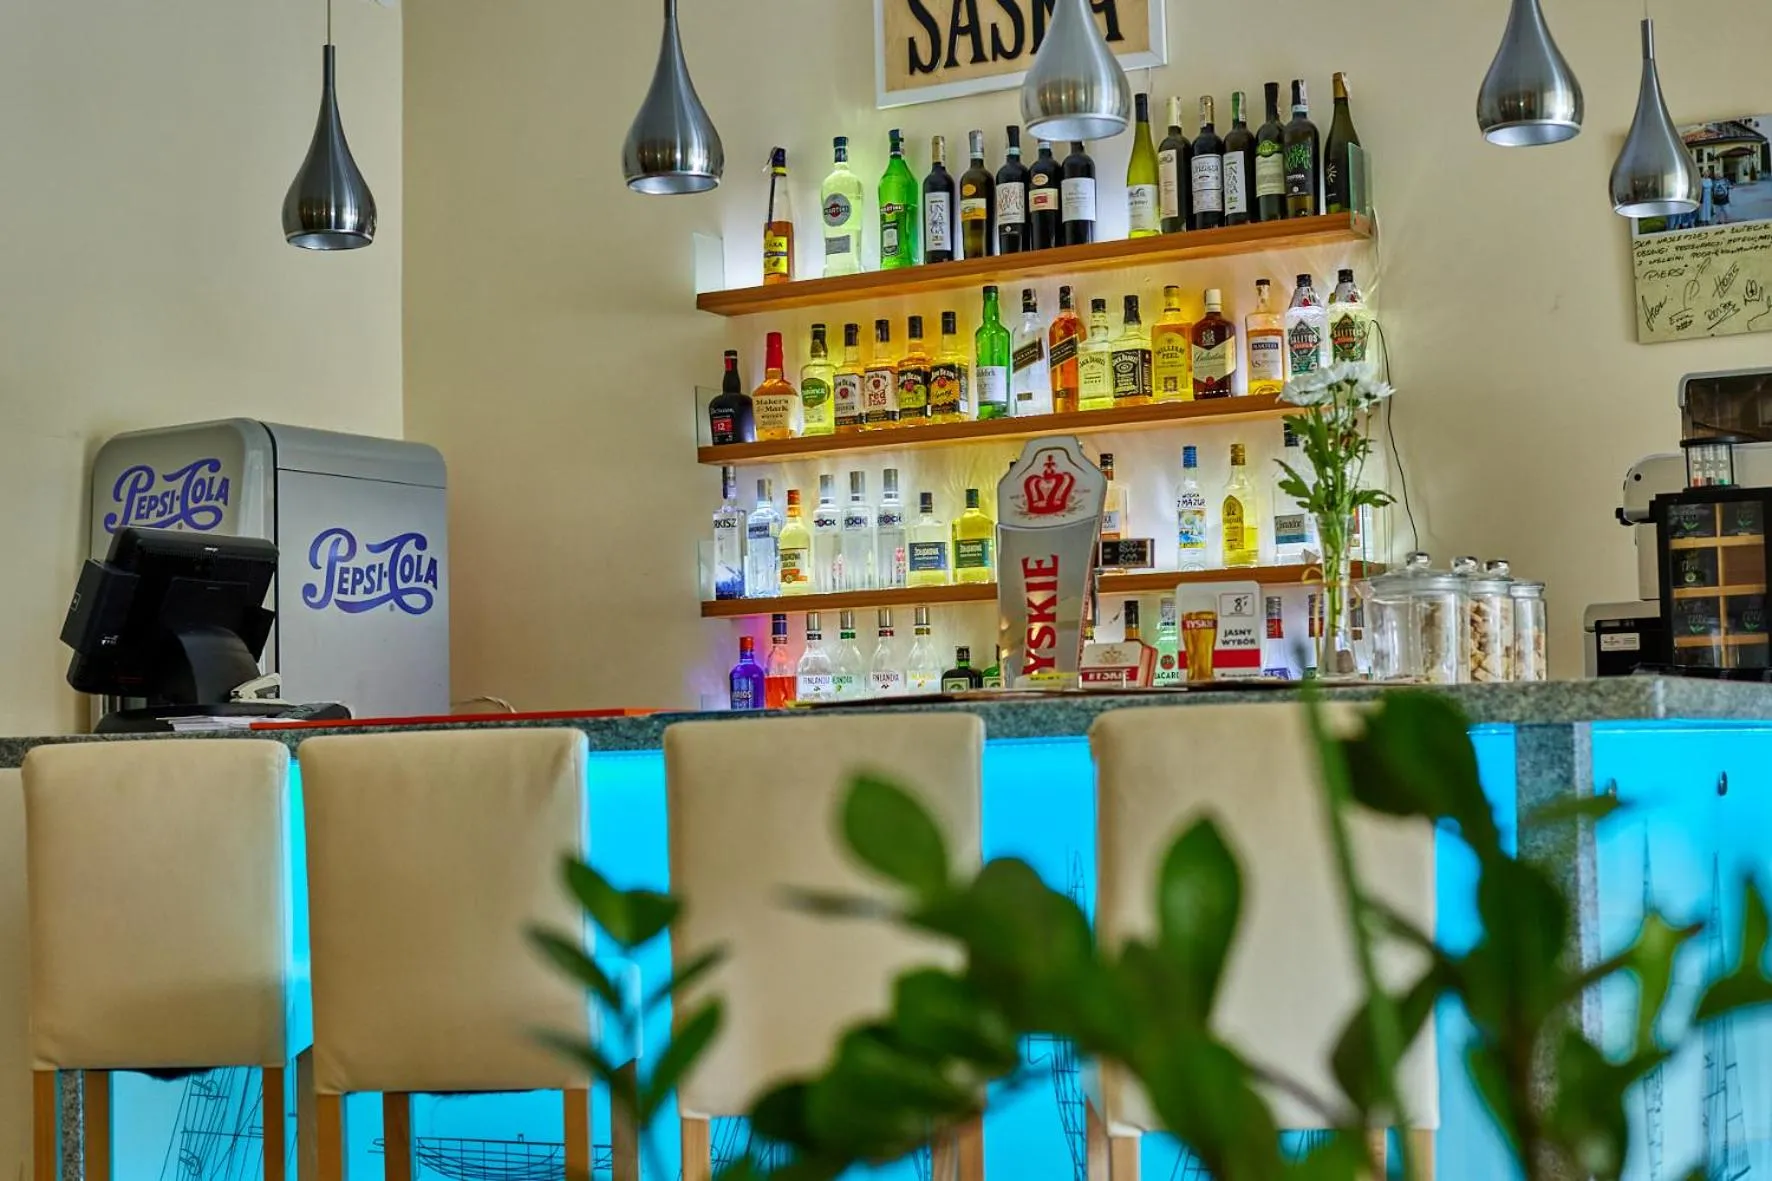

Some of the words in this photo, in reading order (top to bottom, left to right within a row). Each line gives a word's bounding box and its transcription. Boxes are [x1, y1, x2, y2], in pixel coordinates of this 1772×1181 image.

[717, 422, 725, 431] 12
[1224, 628, 1252, 638] JASNY
[1220, 636, 1256, 646] WYBÓR
